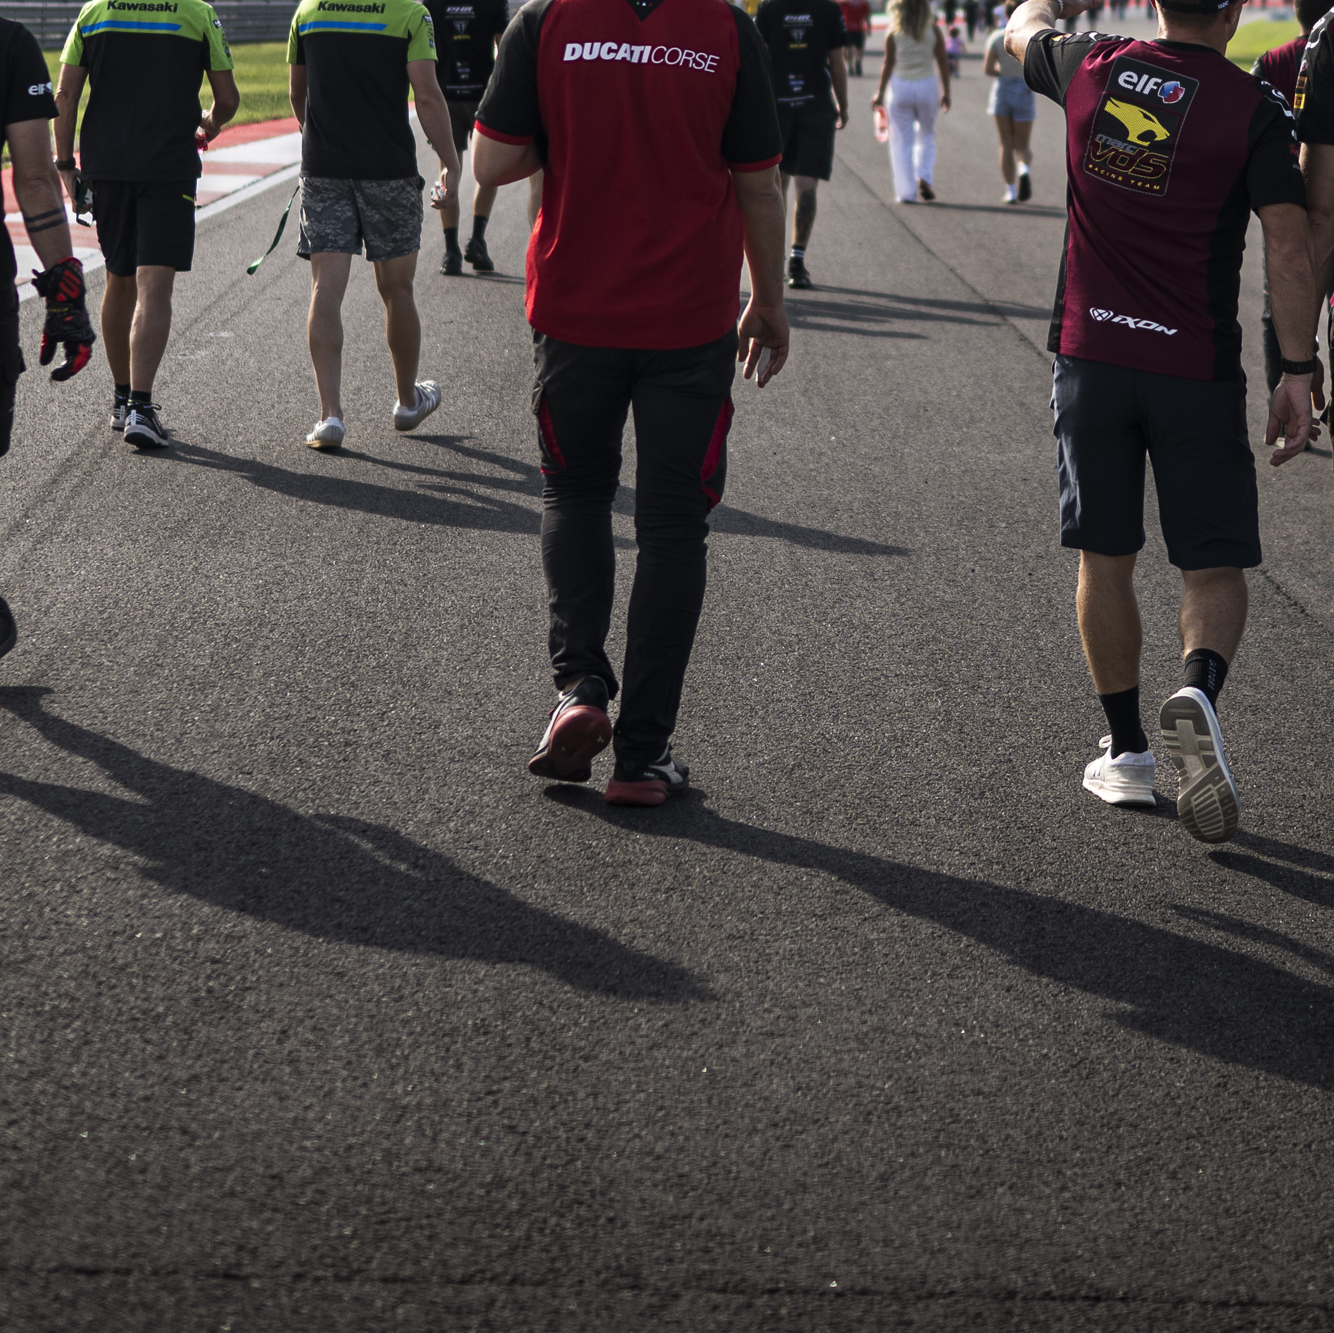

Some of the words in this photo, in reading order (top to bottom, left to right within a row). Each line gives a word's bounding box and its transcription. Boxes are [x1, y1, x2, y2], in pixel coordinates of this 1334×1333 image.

[107, 0, 179, 13] Kawasaki
[317, 1, 386, 14] Kawasaki
[1118, 71, 1162, 95] elf
[1088, 164, 1123, 181] RACING
[1130, 179, 1160, 190] TEAM
